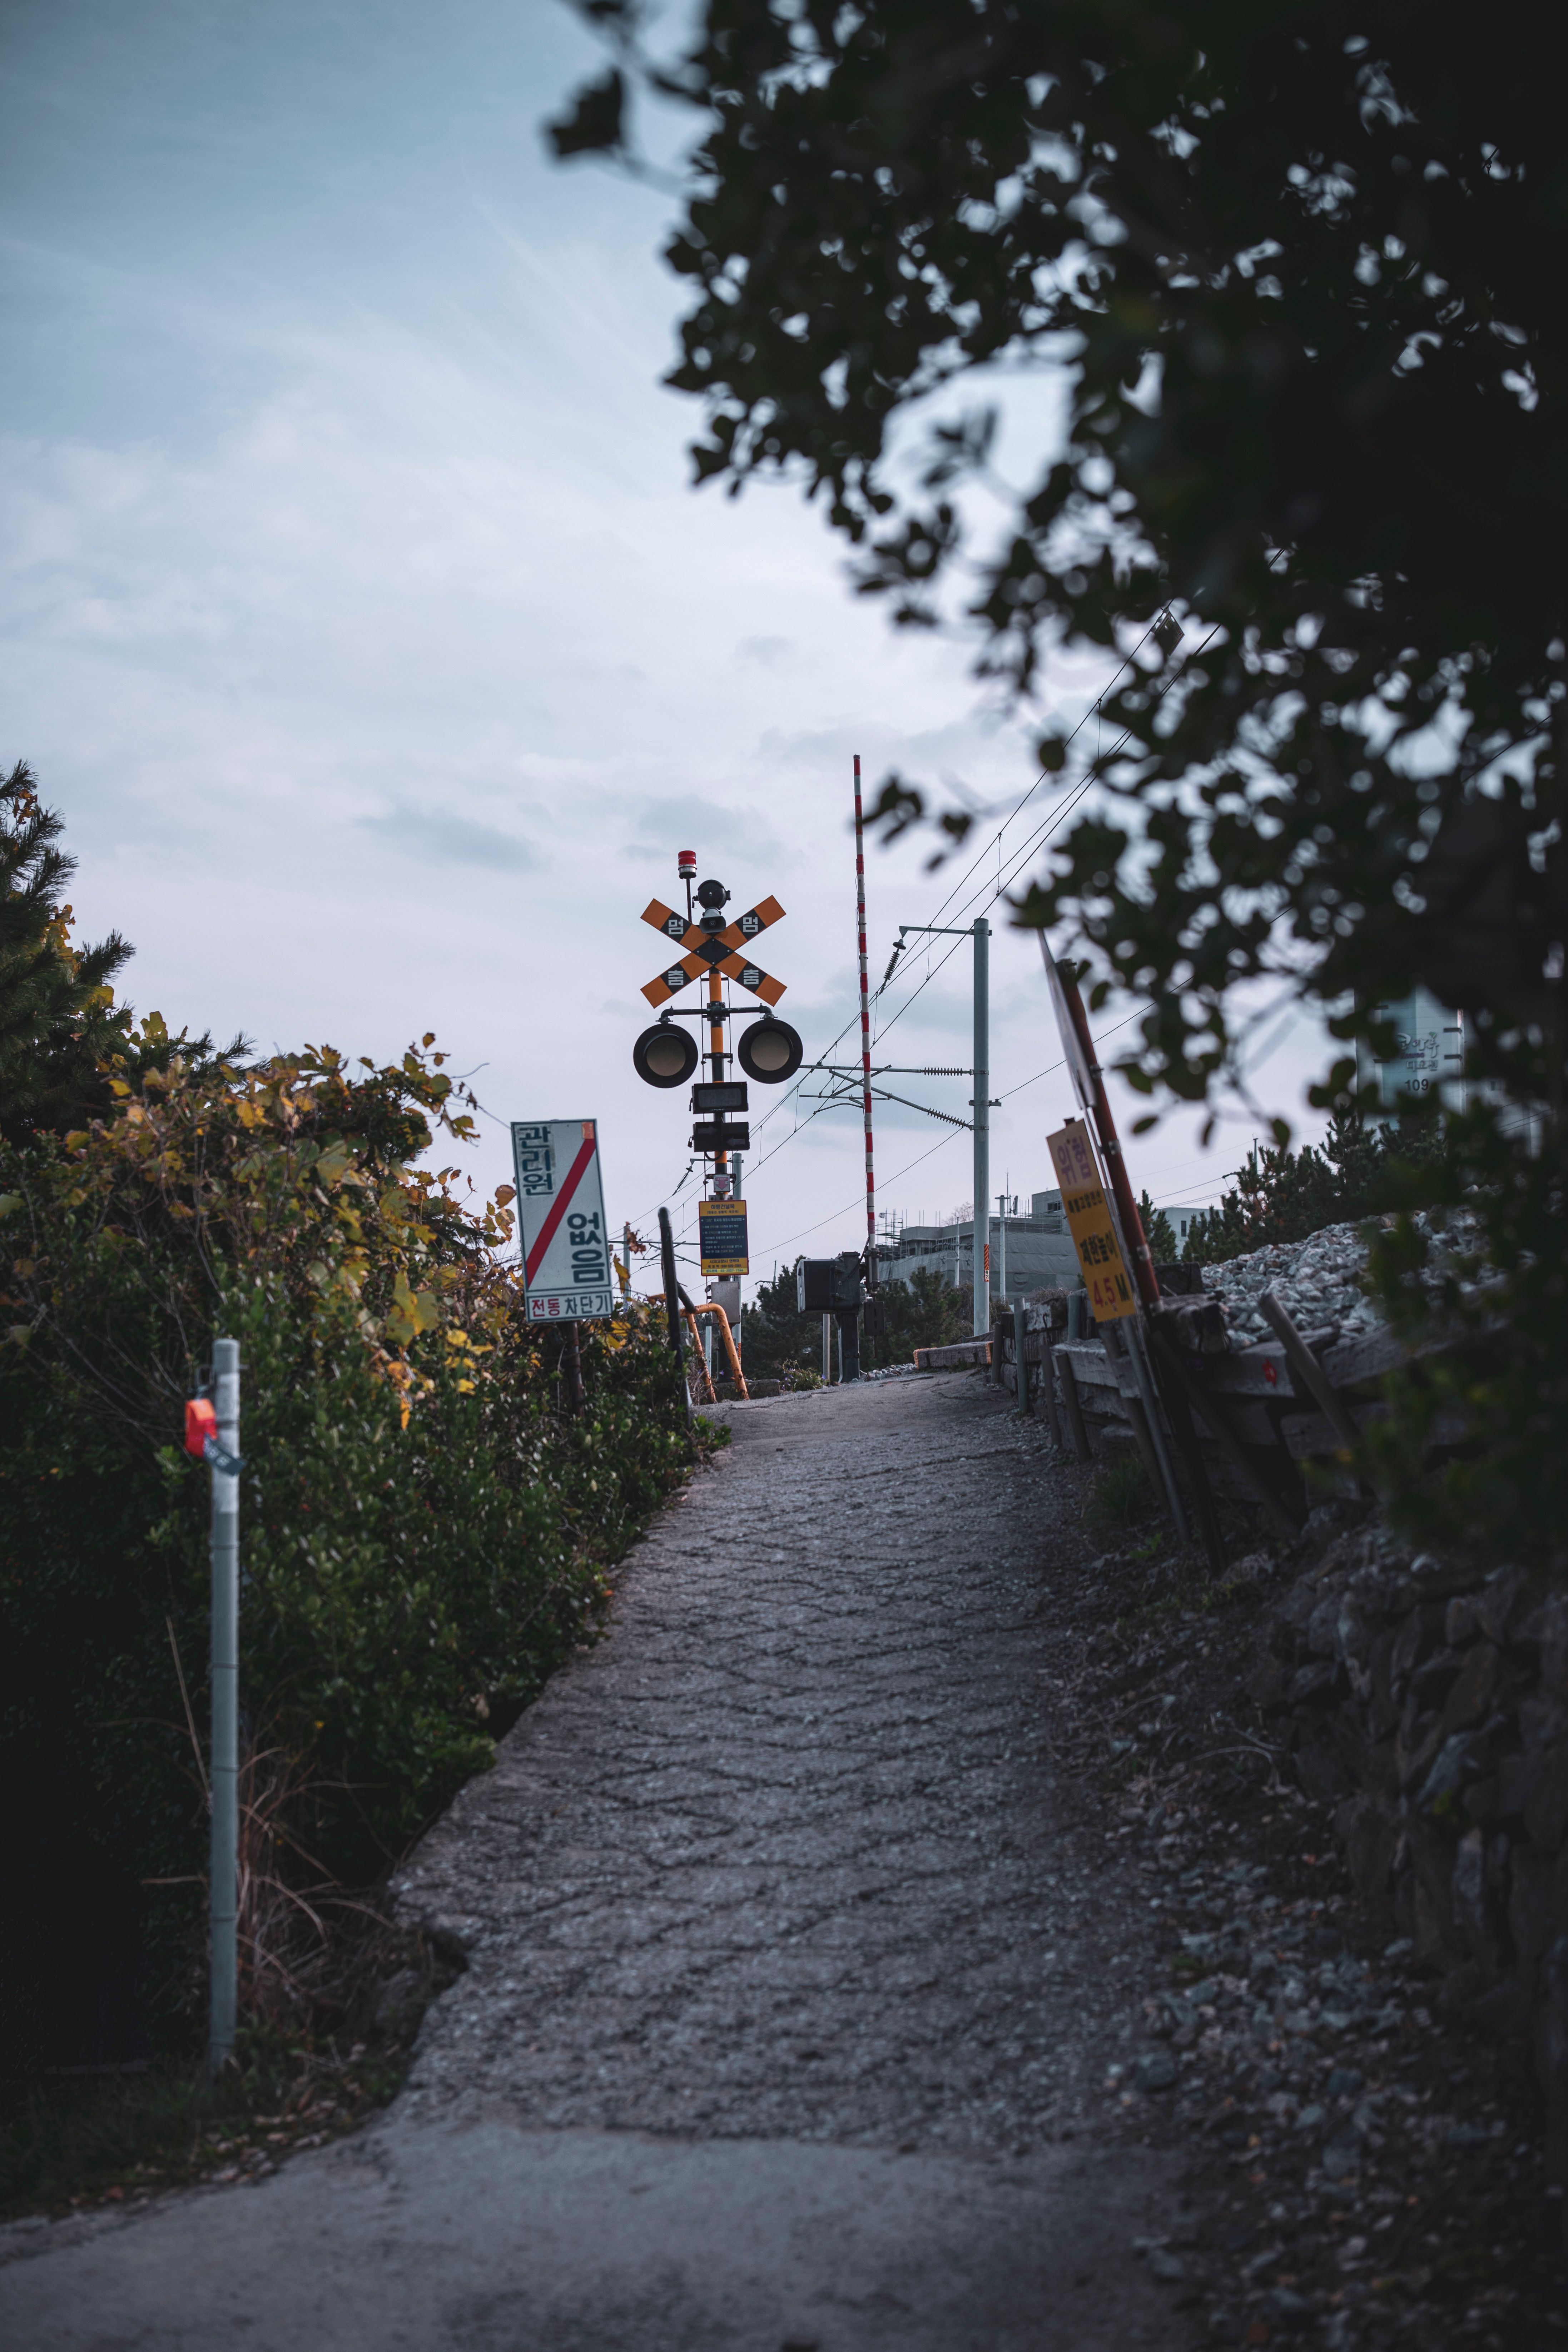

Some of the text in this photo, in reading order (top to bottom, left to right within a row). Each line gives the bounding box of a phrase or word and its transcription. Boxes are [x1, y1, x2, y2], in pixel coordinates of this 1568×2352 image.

[668, 917, 758, 935] 멈 멈
[668, 969, 759, 986] 춤 춤
[1404, 1078, 1429, 1092] 109
[518, 1126, 554, 1196] 관리원
[1057, 1135, 1092, 1185] 위험
[566, 1212, 605, 1284] 없음
[531, 1294, 609, 1318] 전동 차단기
